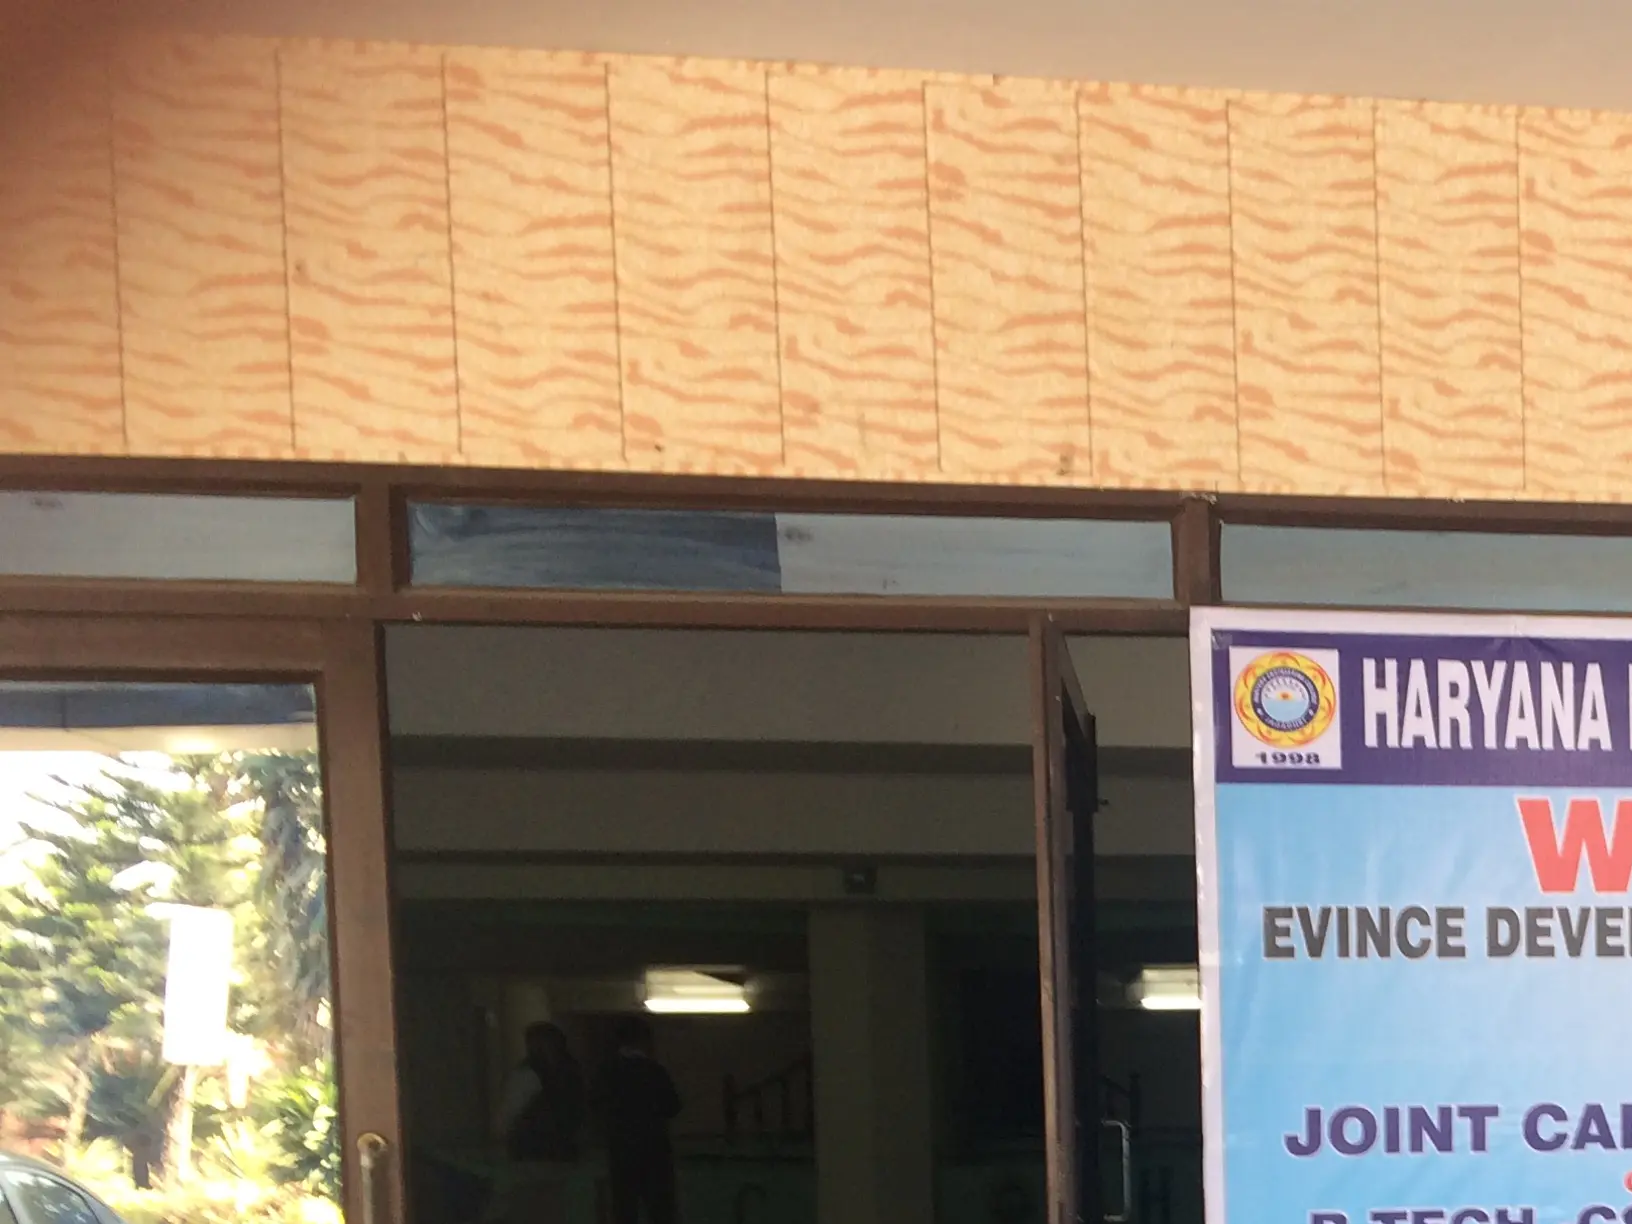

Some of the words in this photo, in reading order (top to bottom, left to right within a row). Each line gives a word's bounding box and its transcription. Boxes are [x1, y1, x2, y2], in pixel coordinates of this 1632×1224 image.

[1362, 657, 1613, 751] HARYANA
[1255, 751, 1321, 765] 1998
[1262, 906, 1467, 960] EVINCE
[1284, 1104, 1500, 1157] JOINT
